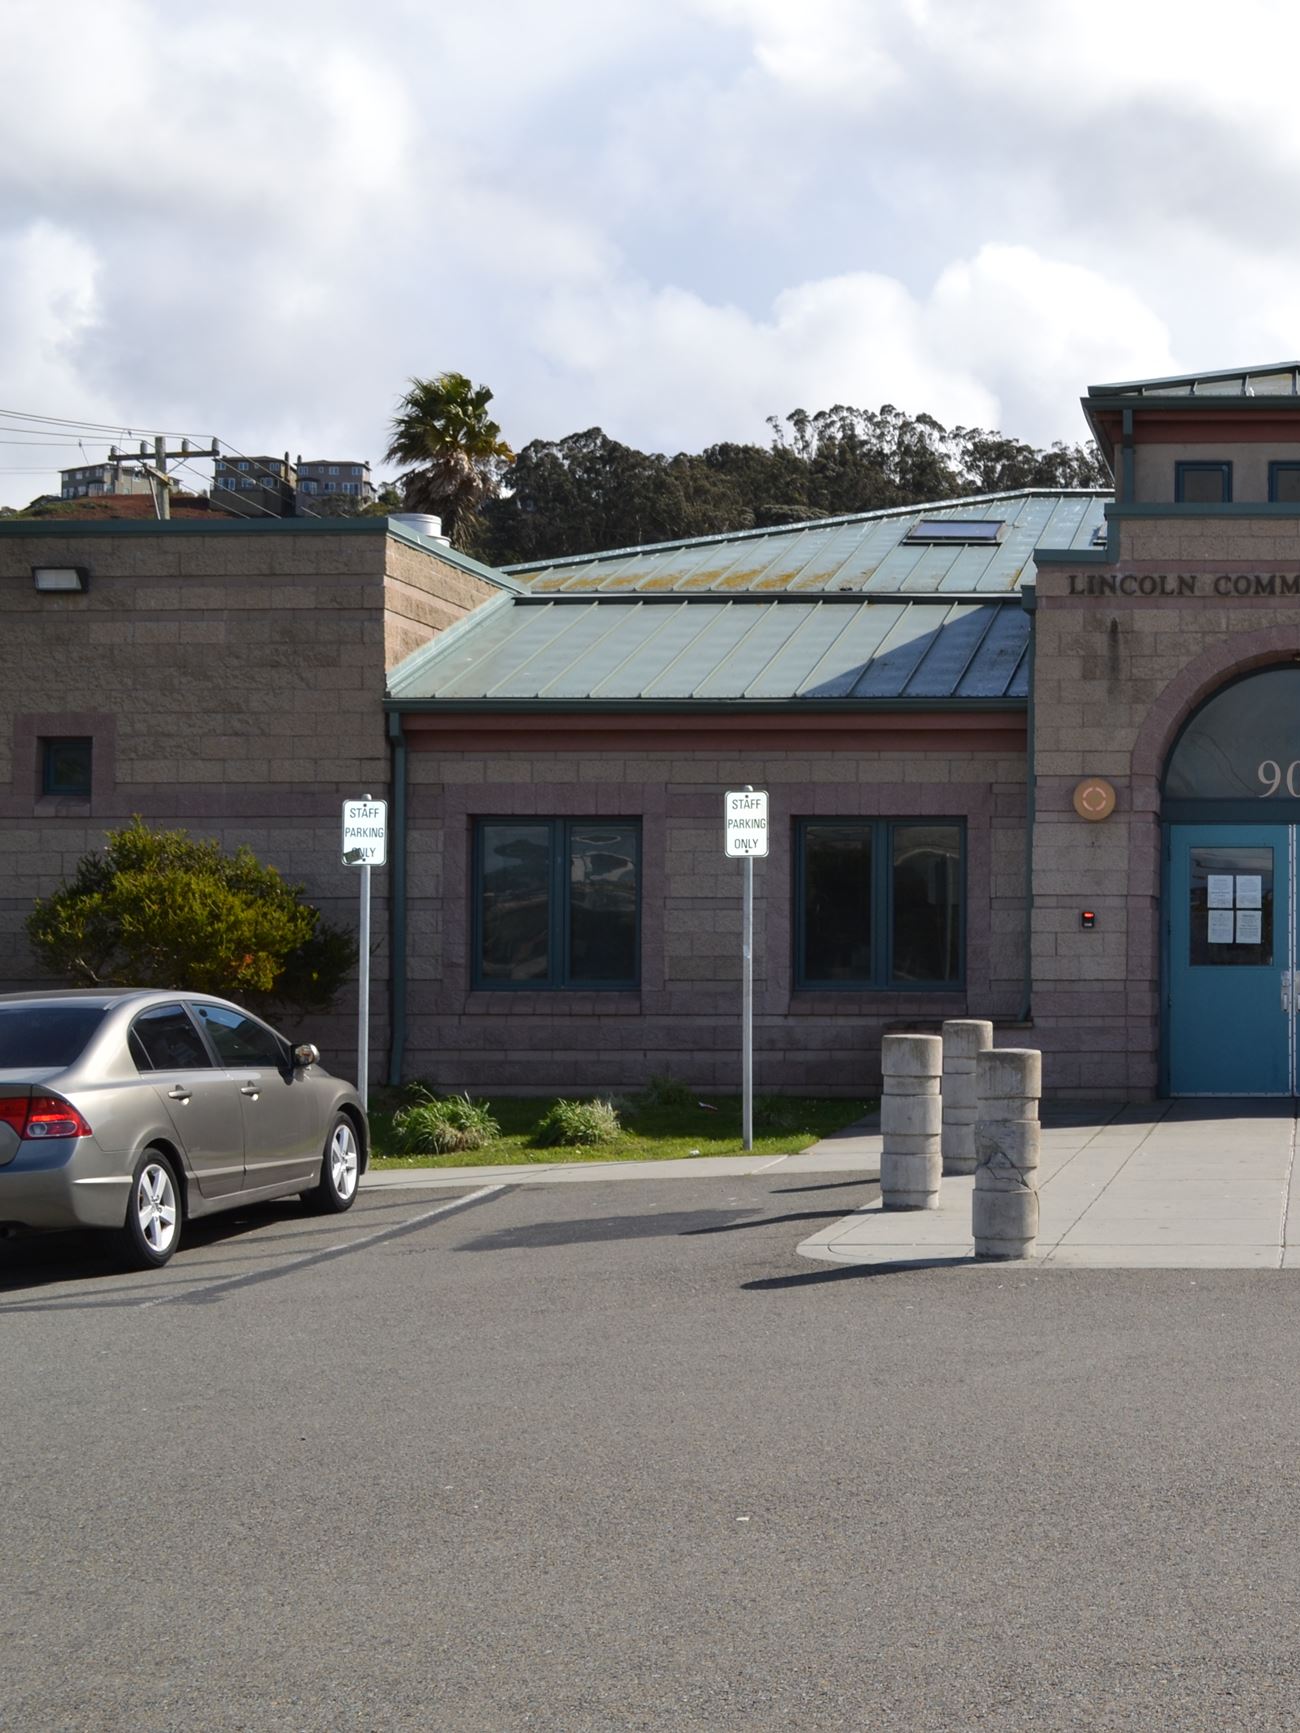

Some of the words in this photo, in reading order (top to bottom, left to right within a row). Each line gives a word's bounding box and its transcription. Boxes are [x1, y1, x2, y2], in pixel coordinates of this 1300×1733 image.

[1068, 574, 1197, 596] LINCOLN
[731, 799, 761, 810] STAFF
[349, 807, 380, 818] STAFF
[727, 818, 766, 829] PARKING
[345, 827, 384, 838] PARKING
[734, 838, 759, 849] ONLY
